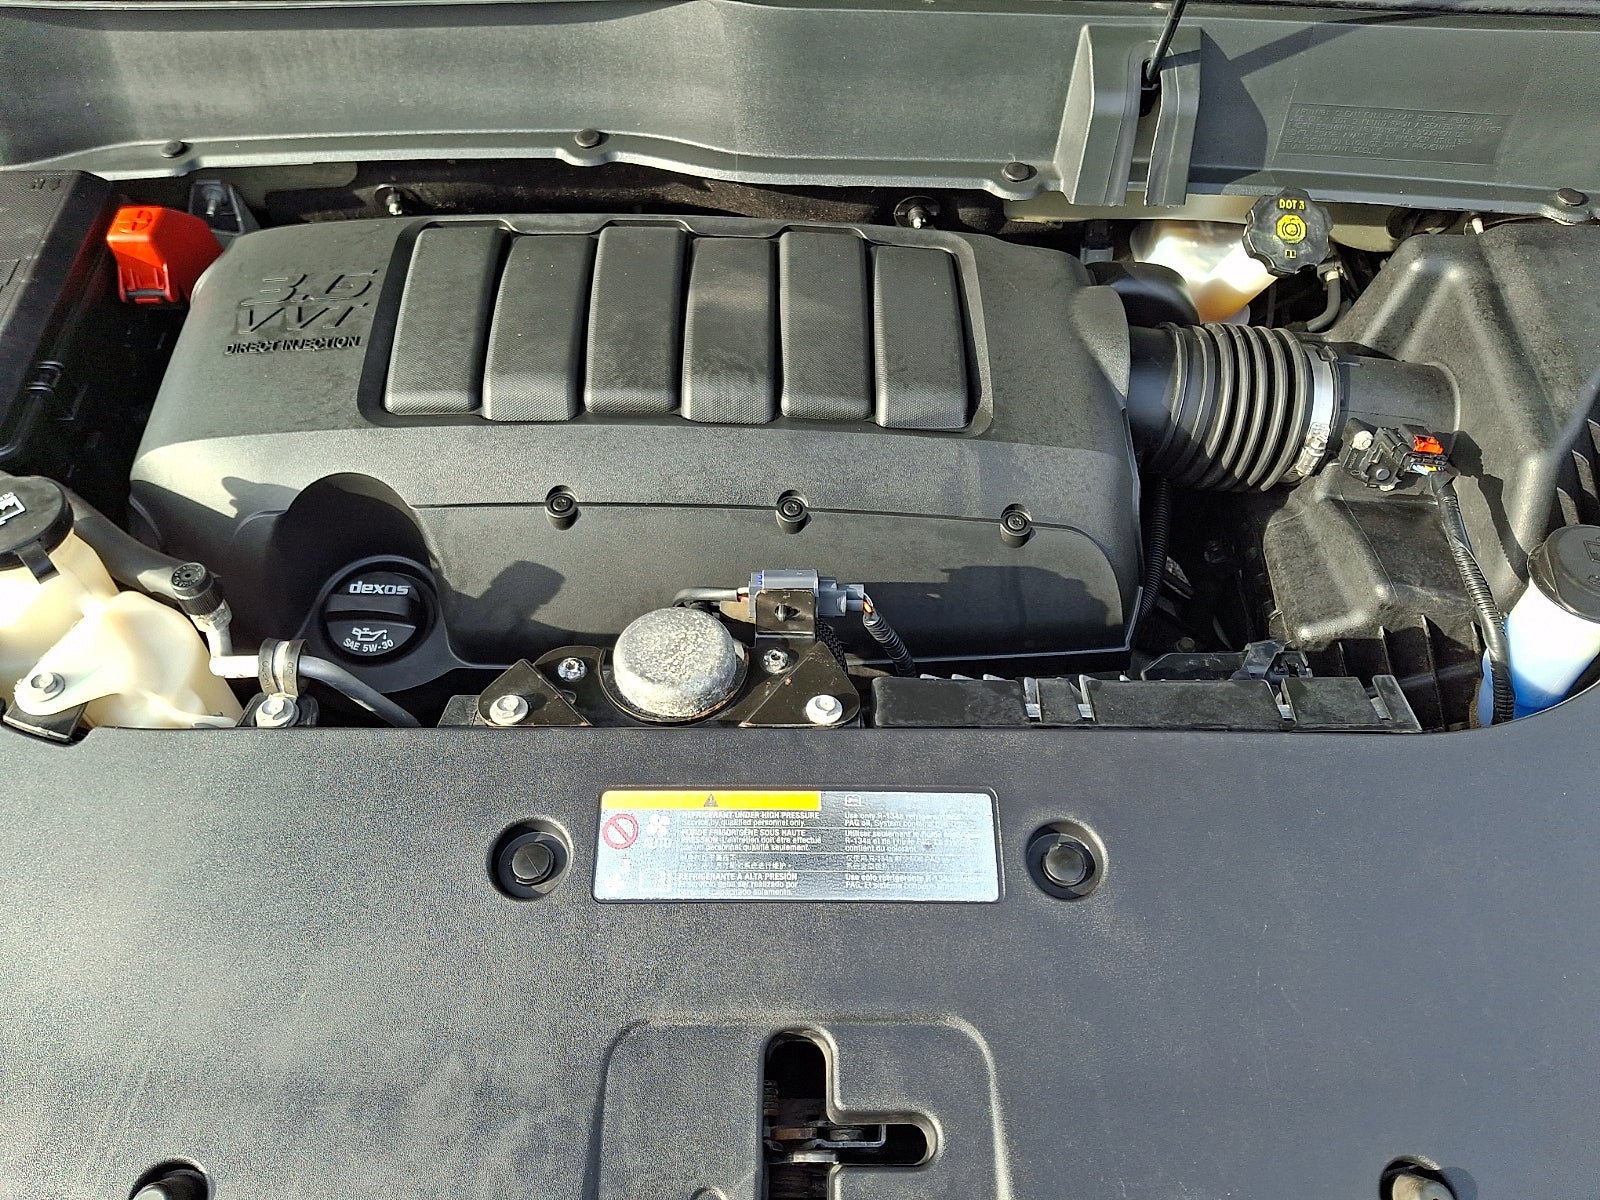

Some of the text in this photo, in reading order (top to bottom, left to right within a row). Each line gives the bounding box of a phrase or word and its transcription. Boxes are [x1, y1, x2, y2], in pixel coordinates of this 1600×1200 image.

[1279, 199, 1305, 210] DOT 3
[224, 335, 362, 355] DIRECT INJECTION
[349, 581, 411, 595] dexos
[343, 638, 393, 652] SAE 5W-30
[760, 829, 780, 837] SOUS
[781, 829, 806, 837] HAUTE
